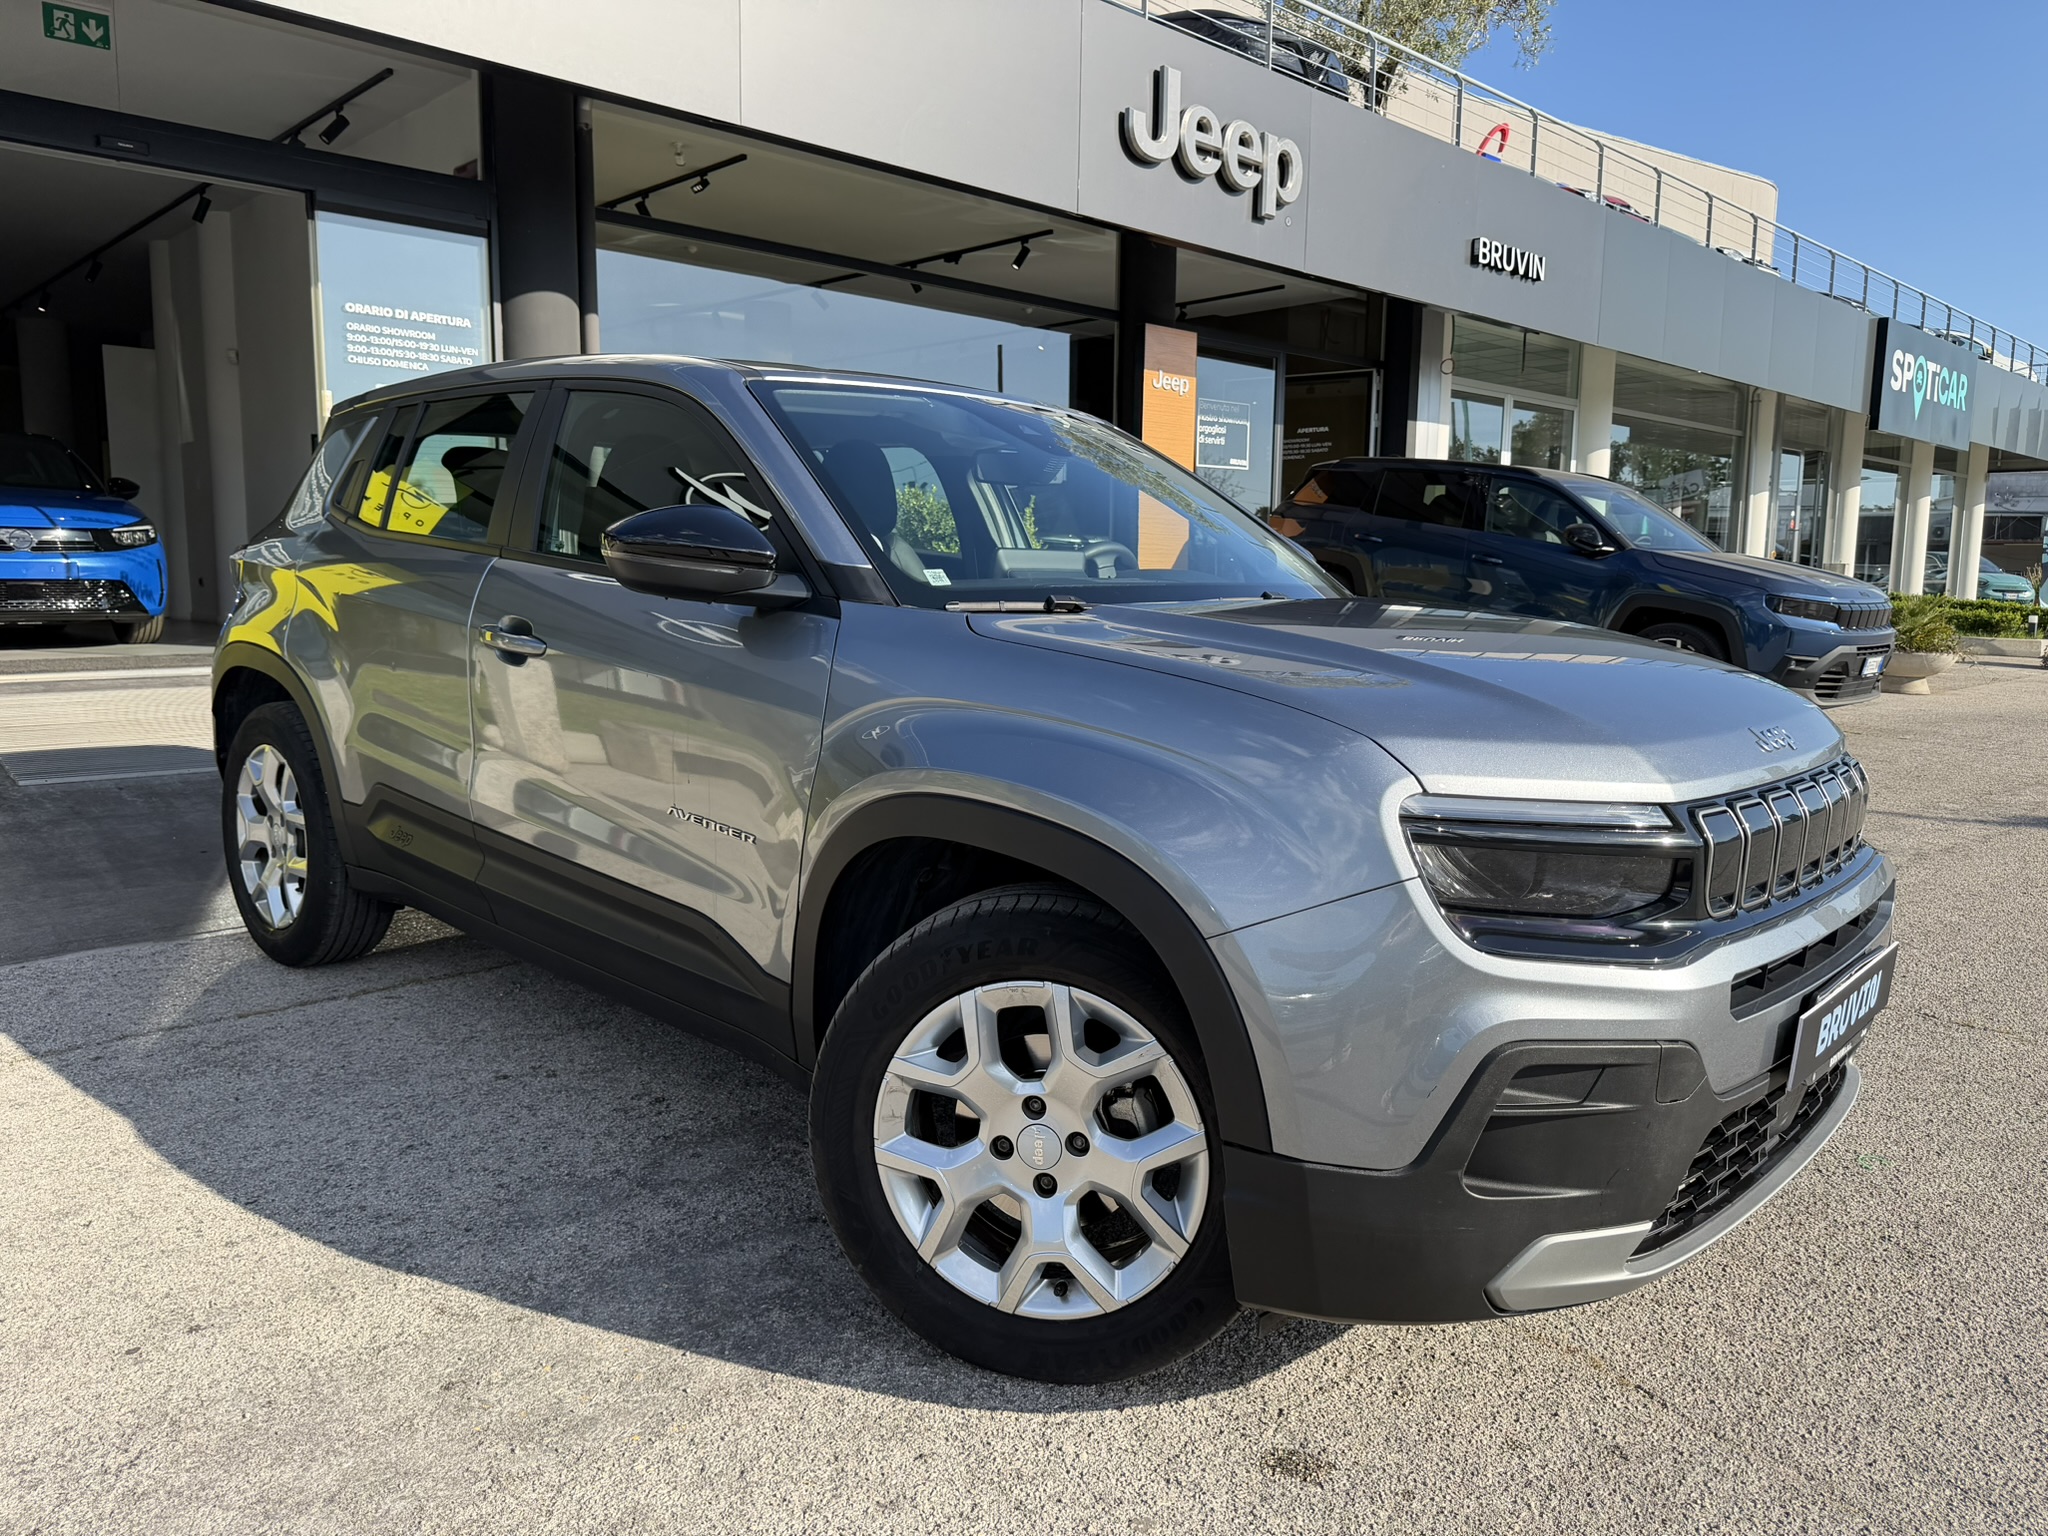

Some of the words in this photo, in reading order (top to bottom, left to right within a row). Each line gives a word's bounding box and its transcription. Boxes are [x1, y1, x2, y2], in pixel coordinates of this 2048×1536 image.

[1123, 65, 1303, 220] Jeep
[1478, 237, 1546, 281] BRUVIN
[344, 303, 393, 317] ORARIO
[395, 309, 409, 320] DI
[410, 311, 472, 328] APERTURA
[346, 322, 381, 334] ORARIO
[381, 326, 436, 340] SHOWROOM
[347, 354, 381, 366] CHIUSO
[440, 354, 473, 366] SABATO
[441, 344, 479, 356] LUN-VEN
[1153, 369, 1189, 395] Jeep
[1747, 726, 1798, 753] Jeep
[389, 826, 414, 848] Jeep
[666, 806, 757, 846] AVENGER
[1815, 969, 1883, 1058] BRUVIN
[1031, 1125, 1046, 1166] Jeep
